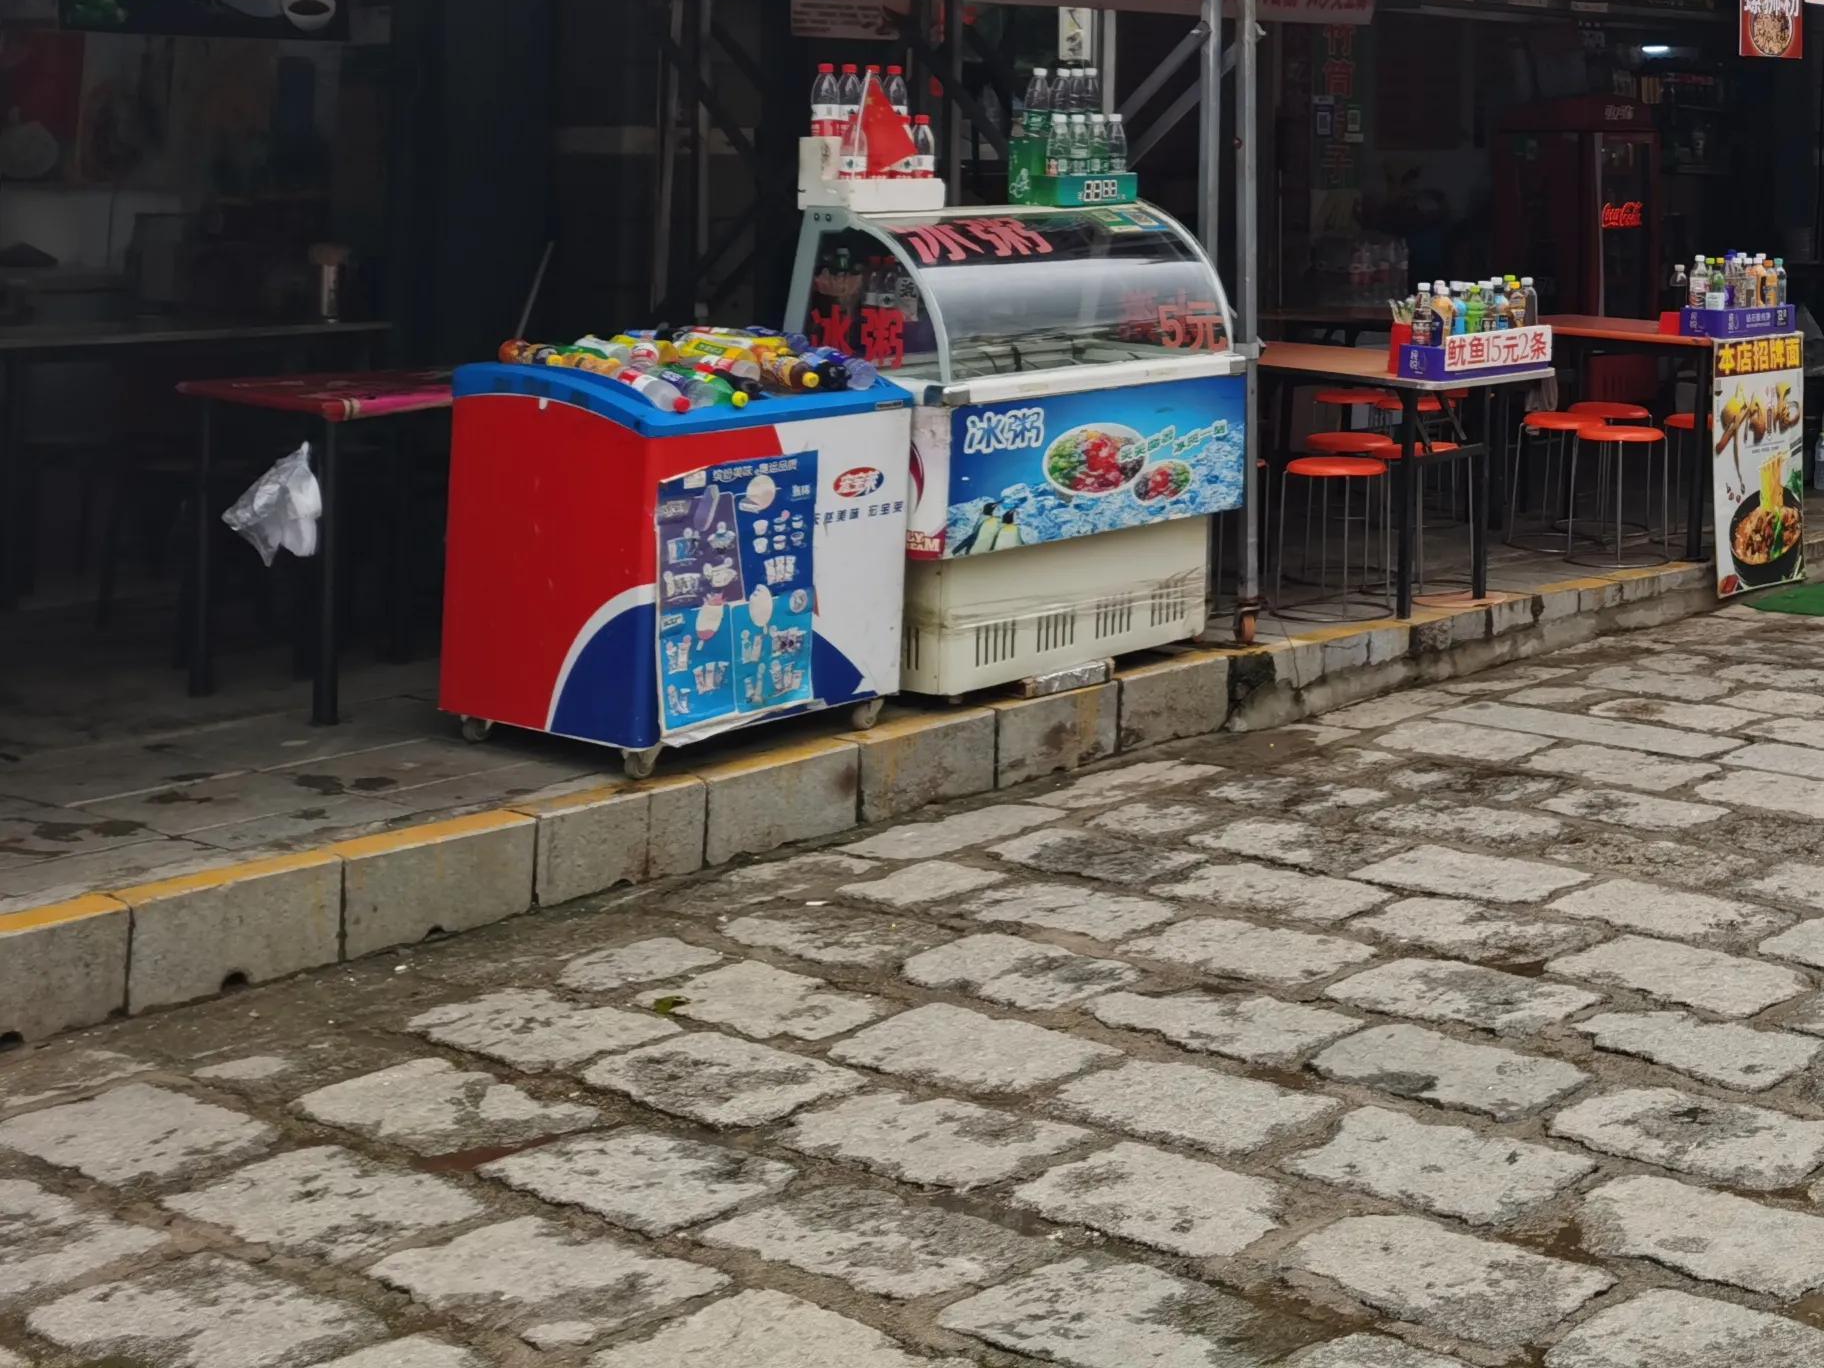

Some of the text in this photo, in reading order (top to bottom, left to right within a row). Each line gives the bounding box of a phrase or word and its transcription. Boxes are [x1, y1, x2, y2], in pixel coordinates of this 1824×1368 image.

[886, 217, 1054, 264] 冰粥
[809, 305, 905, 369] 冰粥
[1159, 303, 1228, 353] 5元
[1447, 332, 1547, 367] 鱿鱼15元2条
[1717, 338, 1801, 374] 本店招牌面
[964, 406, 1045, 455] 冰粥
